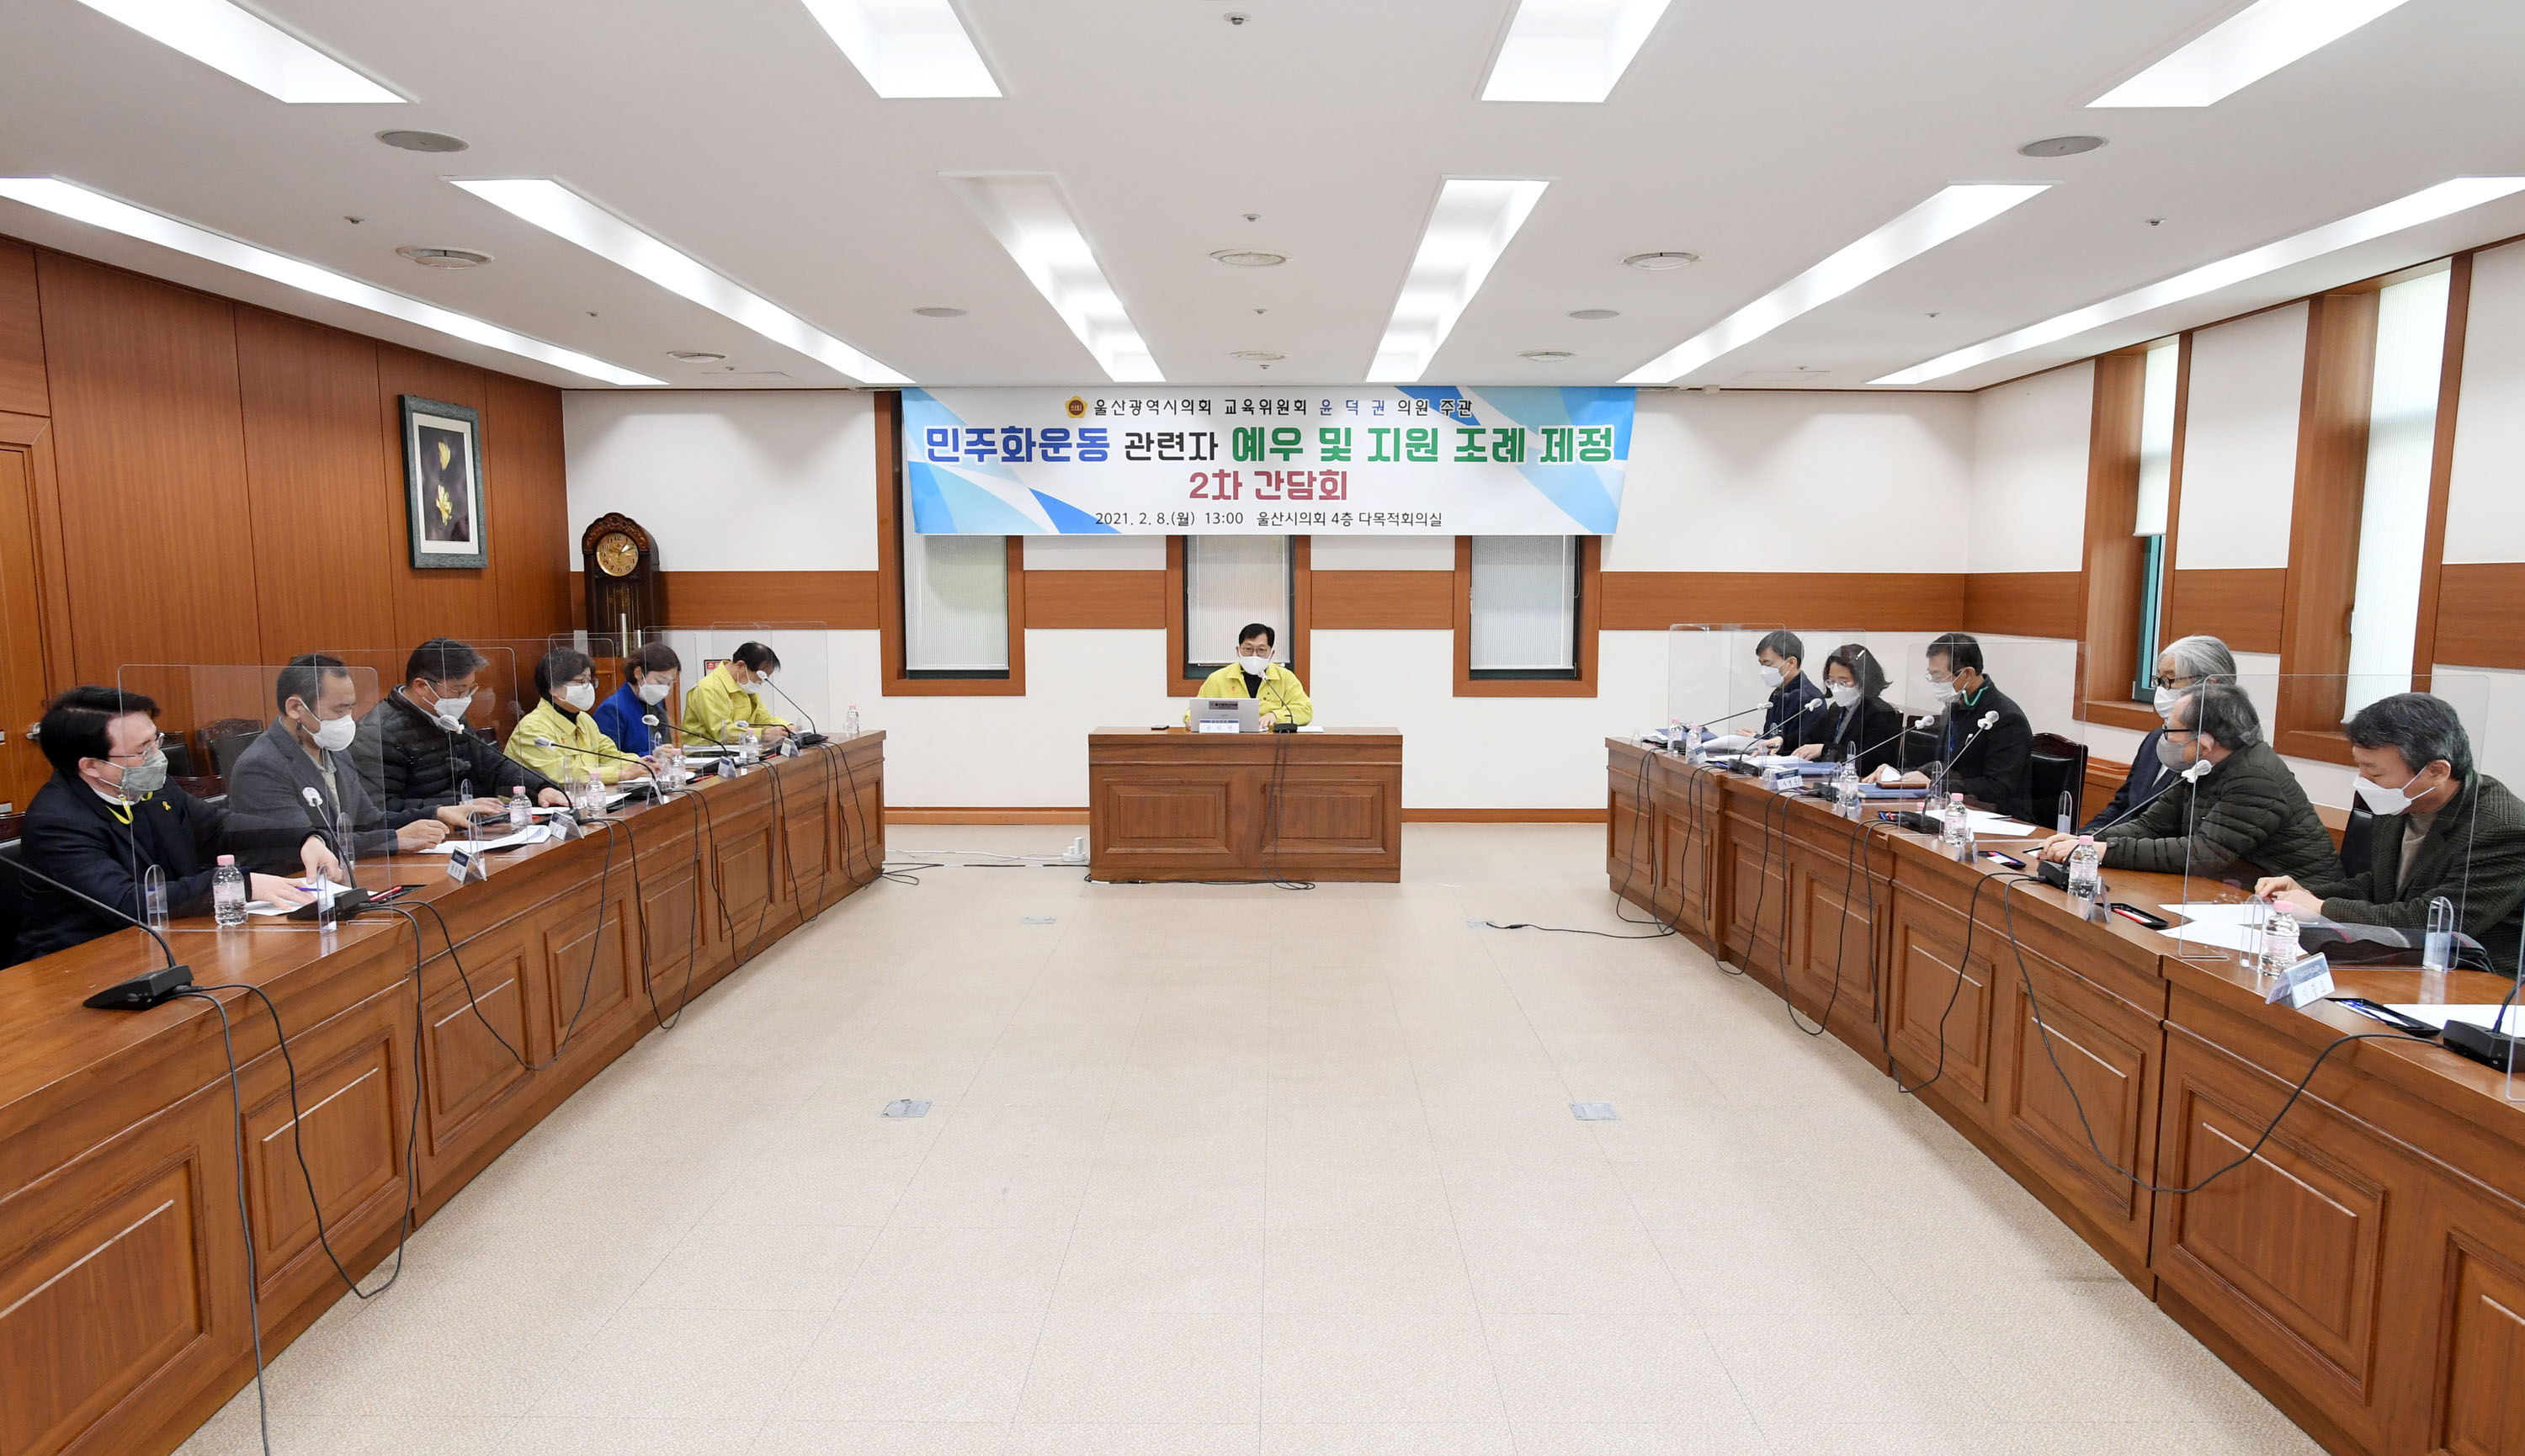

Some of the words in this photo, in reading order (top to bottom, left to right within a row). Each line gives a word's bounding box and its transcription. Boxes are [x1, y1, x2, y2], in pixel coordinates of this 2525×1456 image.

[1094, 398, 1211, 416] 울산광역시의회
[1225, 398, 1306, 416] 교육위원회
[1397, 399, 1428, 417] 의원
[1440, 399, 1473, 417] 주관
[926, 426, 1110, 463] 민주화운동
[1124, 432, 1219, 462] 관련자
[1232, 427, 1304, 463] 예우
[1319, 428, 1352, 462] 및
[1368, 428, 1438, 463] 지원
[1454, 428, 1525, 463] 조례
[1540, 428, 1613, 463] 제정
[1189, 469, 1243, 501] 2차
[1253, 469, 1348, 501] 간담회
[1095, 512, 1134, 525] 2021.
[1139, 512, 1151, 525] 2.
[1156, 511, 1195, 527] 8.(월)
[1205, 512, 1243, 525] 13:00
[1257, 511, 1326, 527] 울산시의회
[1331, 512, 1353, 527] 4층
[1358, 512, 1442, 527] 다목적회의실
